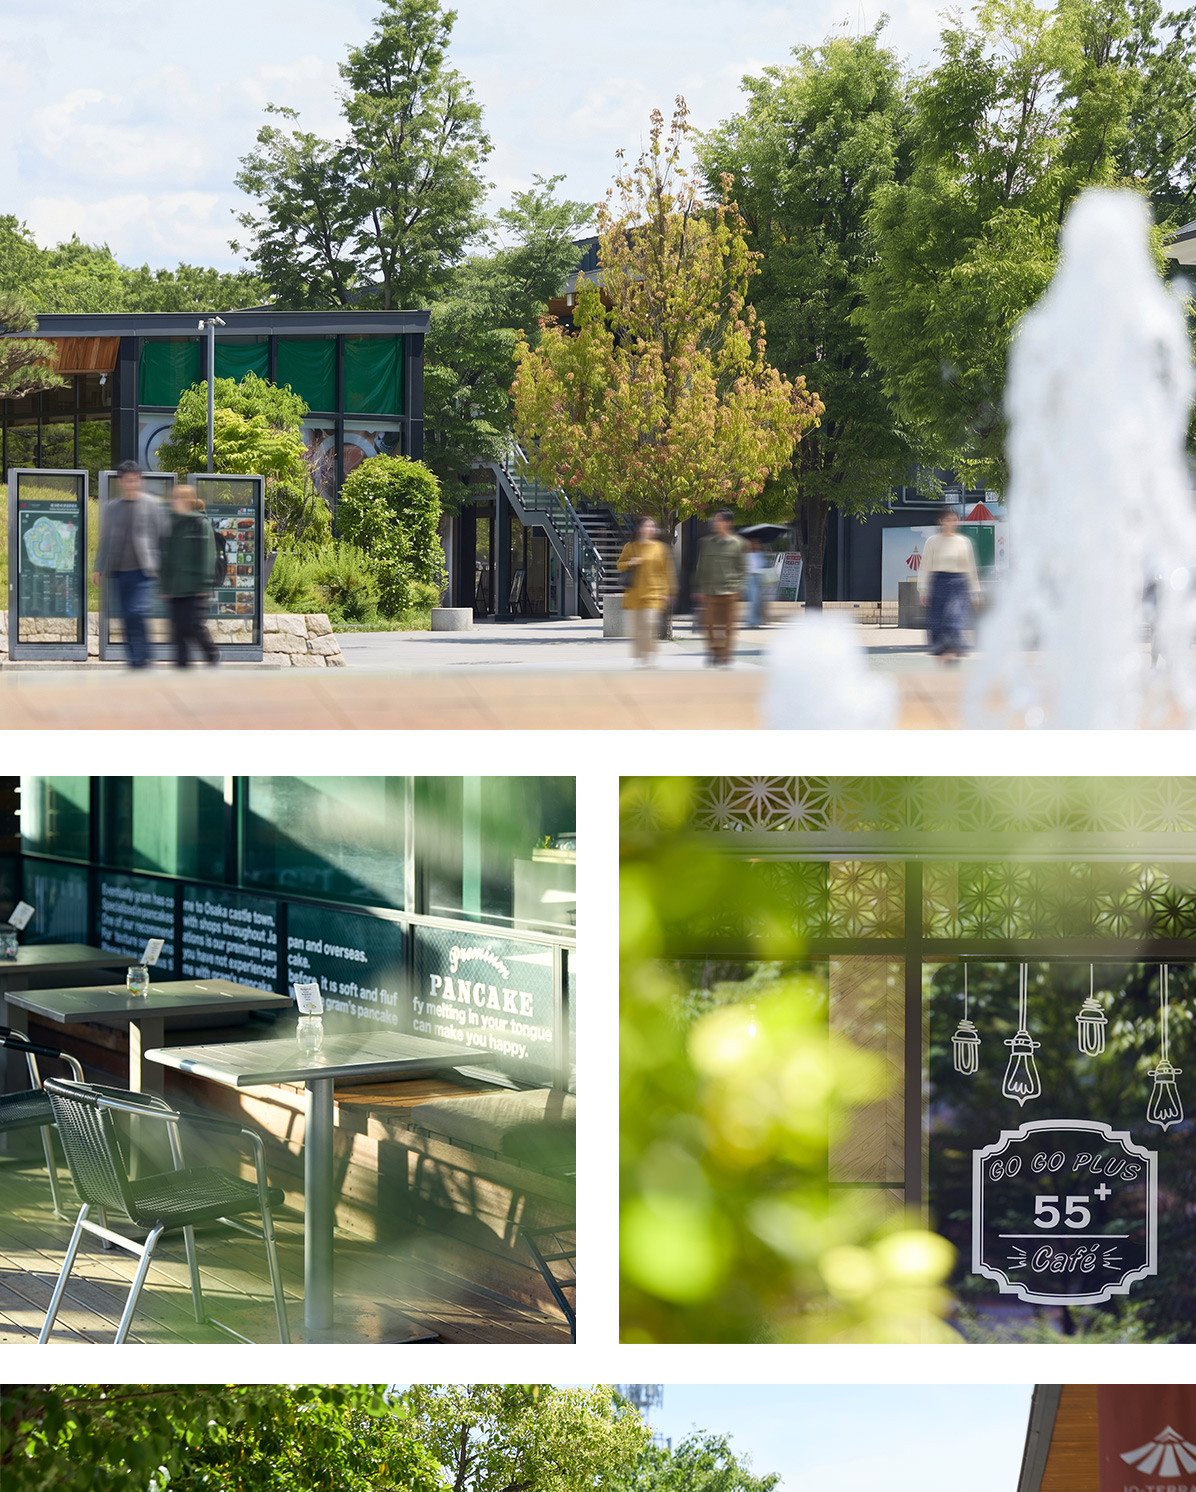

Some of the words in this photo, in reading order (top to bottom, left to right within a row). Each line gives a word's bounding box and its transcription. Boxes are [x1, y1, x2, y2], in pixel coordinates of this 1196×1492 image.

[195, 901, 203, 914] to
[204, 901, 228, 919] Osaka
[228, 908, 252, 923] castle
[252, 911, 275, 927] town.
[183, 914, 198, 929] with
[199, 917, 221, 935] shops
[222, 921, 266, 943] throughout
[287, 936, 304, 950] pan
[305, 940, 322, 954] and
[323, 943, 368, 963] overseas.
[205, 933, 212, 948] is
[212, 938, 226, 951] our
[226, 942, 260, 959] premium
[287, 953, 311, 969] cake.
[182, 948, 195, 961] you
[196, 948, 213, 965] have
[214, 954, 228, 968] not
[228, 958, 277, 979] experienced
[321, 975, 328, 991] it
[329, 981, 337, 993] is
[338, 982, 358, 997] soft
[359, 985, 377, 1002] and
[379, 989, 398, 1006] fluf
[413, 996, 424, 1015] fy
[426, 1001, 466, 1026] melting
[468, 1008, 479, 1026] in
[481, 1014, 508, 1031] your
[510, 1019, 553, 1043] tongue
[430, 973, 533, 1018] PANCAKE
[326, 998, 356, 1017] gram's
[357, 1005, 399, 1026] pancake
[413, 1019, 431, 1034] can
[434, 1024, 463, 1042] make
[466, 1031, 487, 1047] you
[489, 1034, 529, 1060] happy.
[989, 1155, 1022, 1182] GO
[1031, 1151, 1066, 1173] GO
[1072, 1152, 1141, 1181] PLUS
[1031, 1243, 1100, 1273] Café
